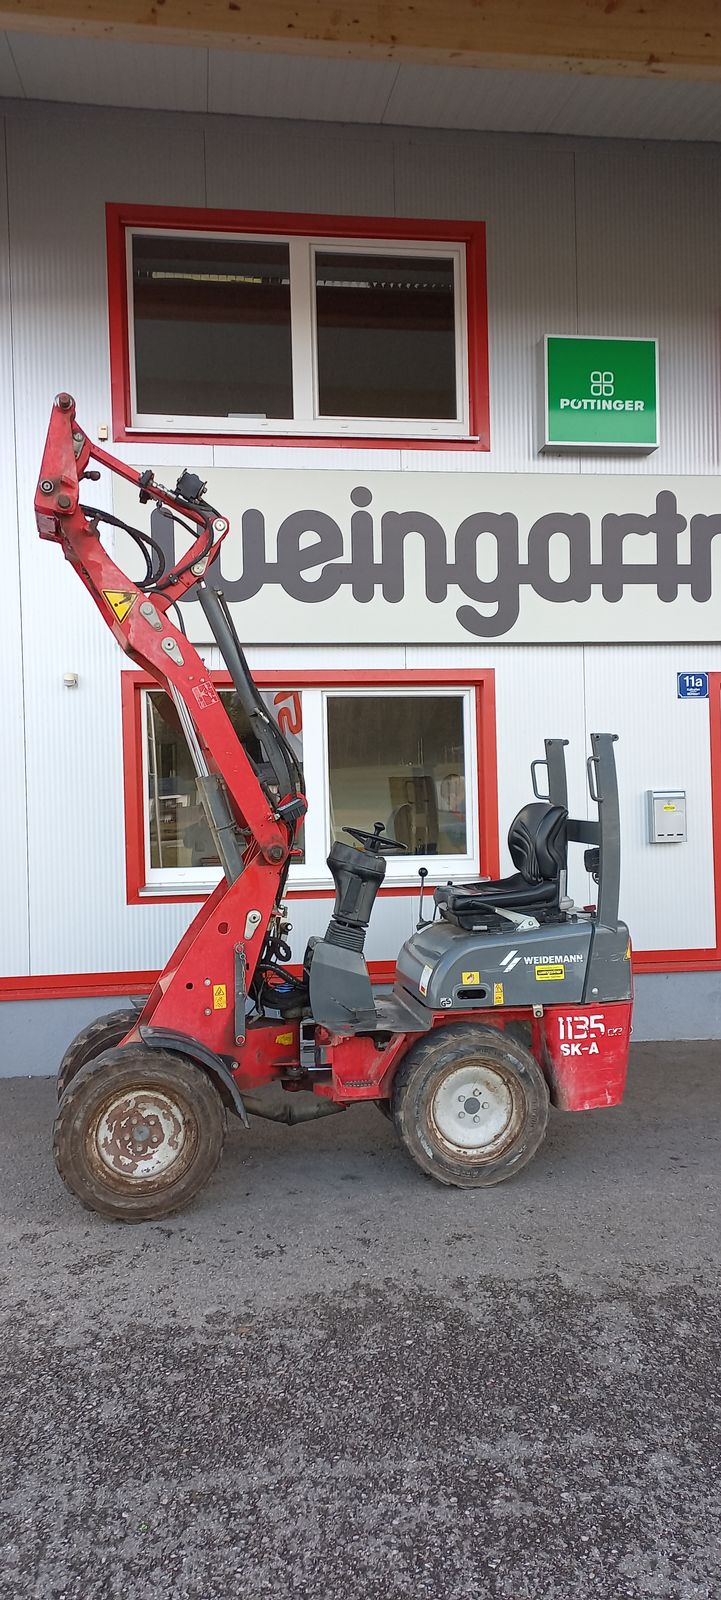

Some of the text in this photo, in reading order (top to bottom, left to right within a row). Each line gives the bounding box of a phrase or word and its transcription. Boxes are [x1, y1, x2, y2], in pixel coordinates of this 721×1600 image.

[560, 399, 645, 411] PÖTTINGER
[684, 676, 703, 687] 11a
[524, 954, 584, 965] WEIDEMANN
[558, 1014, 605, 1040] 1135
[560, 1042, 600, 1056] SK-A
